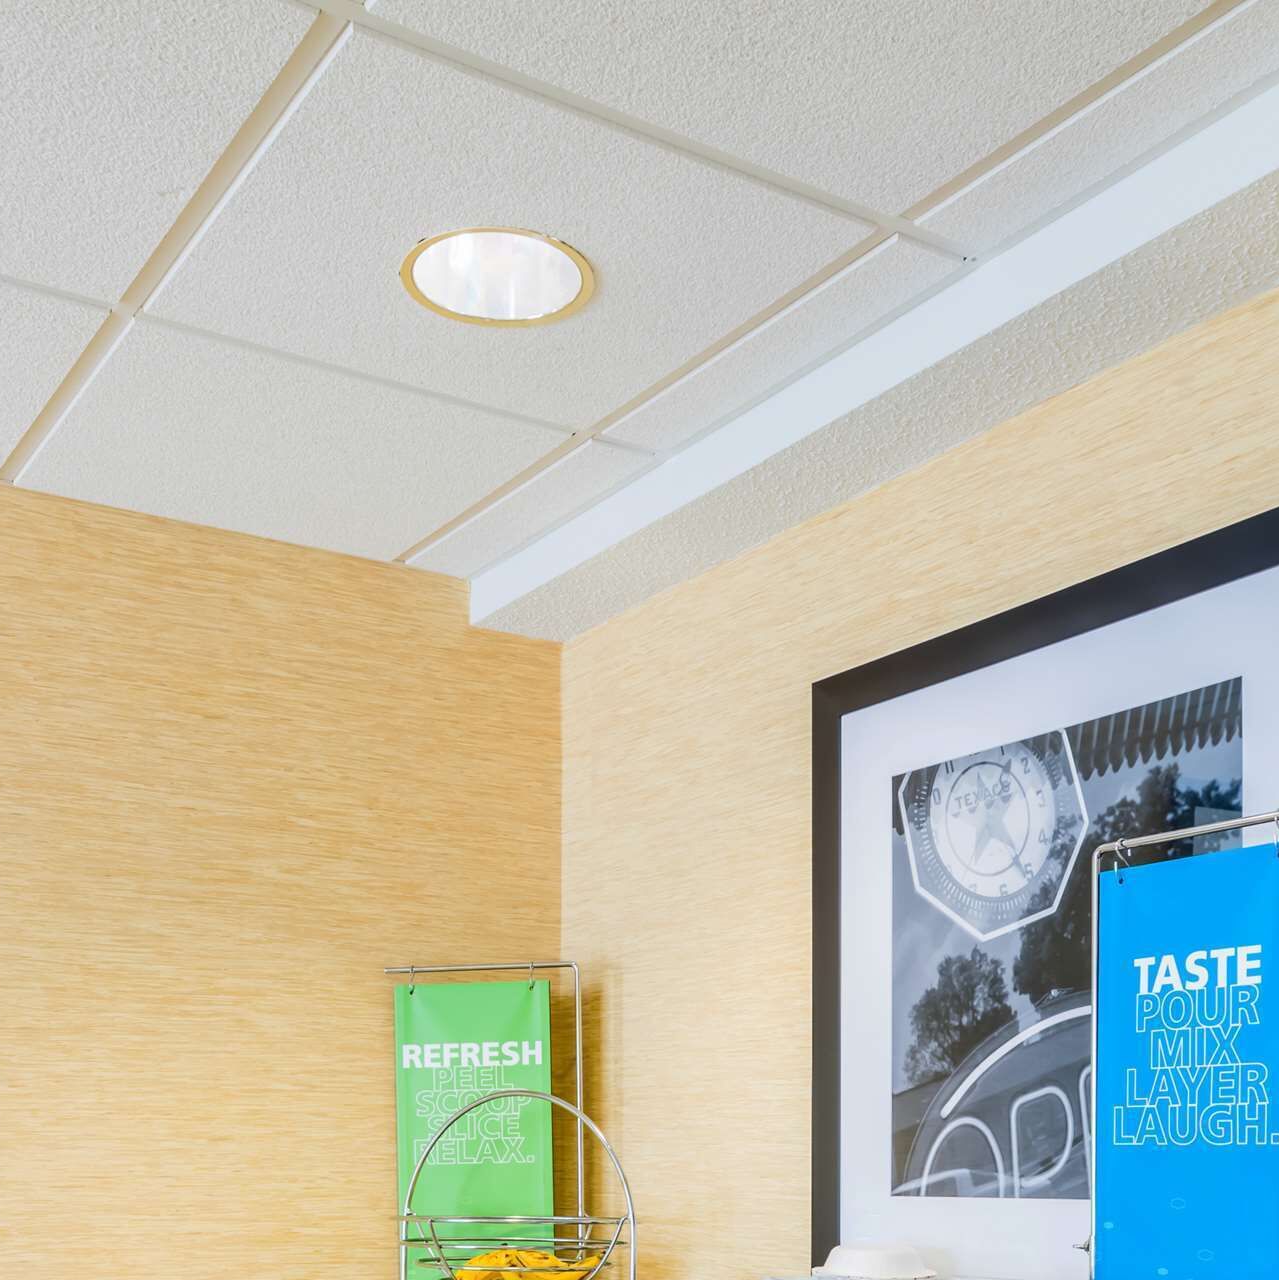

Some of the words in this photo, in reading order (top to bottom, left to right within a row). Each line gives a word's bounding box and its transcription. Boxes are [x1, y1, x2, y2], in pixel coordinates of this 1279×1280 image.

[1133, 944, 1262, 995] TASTE
[1136, 984, 1260, 1033] POUR
[401, 1040, 543, 1069] REFRESH
[1150, 1023, 1242, 1070] MIX
[433, 1064, 515, 1092] PEEL
[1126, 1062, 1269, 1108] LAYER
[415, 1089, 532, 1116] SCOOP
[427, 1113, 521, 1141] SLICE
[413, 1137, 535, 1165] RELAX.
